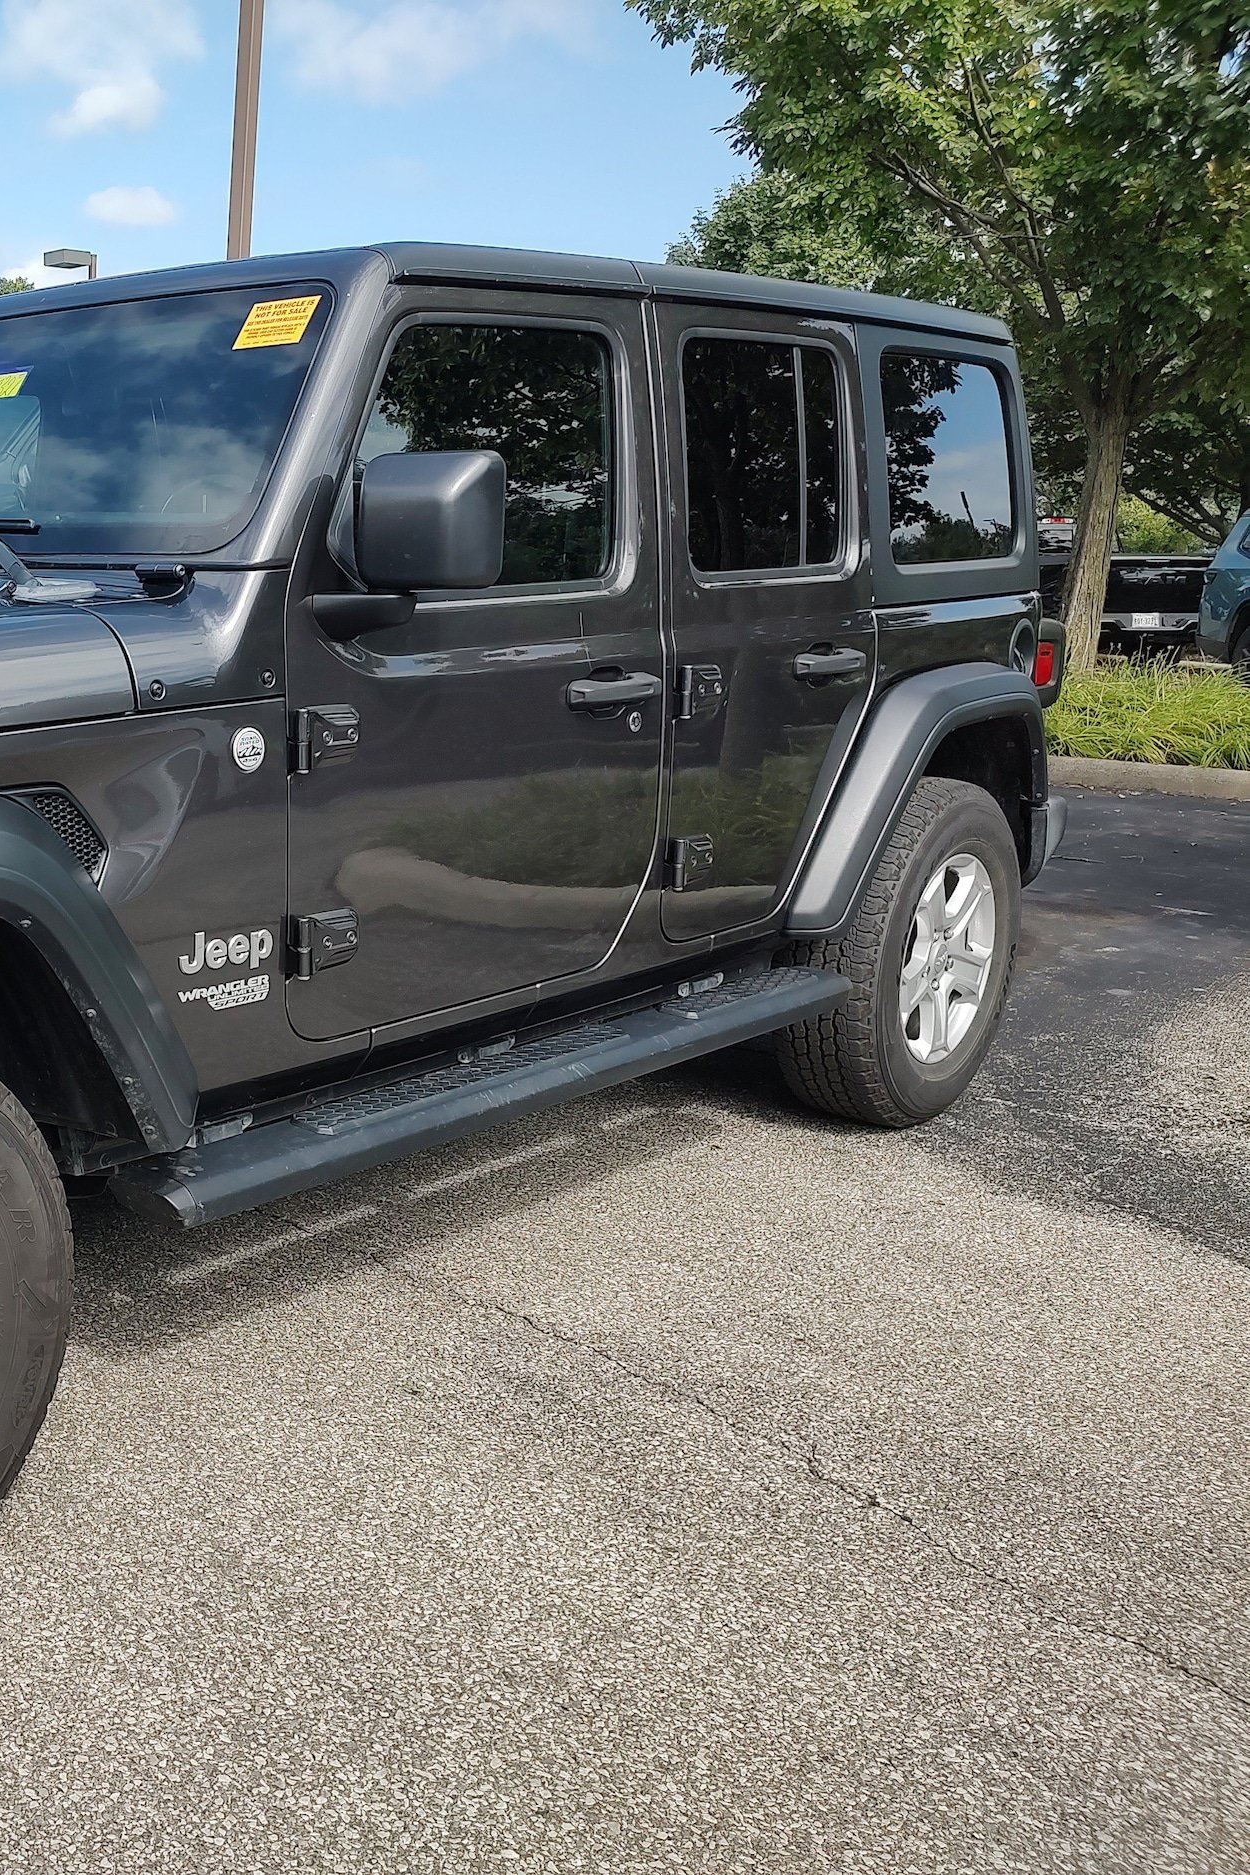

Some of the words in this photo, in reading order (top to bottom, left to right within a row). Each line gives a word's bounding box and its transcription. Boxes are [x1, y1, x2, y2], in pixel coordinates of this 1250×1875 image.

[254, 311, 269, 319] NOT
[271, 309, 287, 317] FOR
[288, 307, 308, 315] SALE
[274, 301, 305, 309] VEHICLE
[1122, 575, 1187, 585] RAM
[178, 928, 274, 975] Jeep
[177, 974, 270, 1003] WRANGLER
[207, 984, 270, 1001] UNLIMITED
[213, 991, 267, 1009] SPORT
